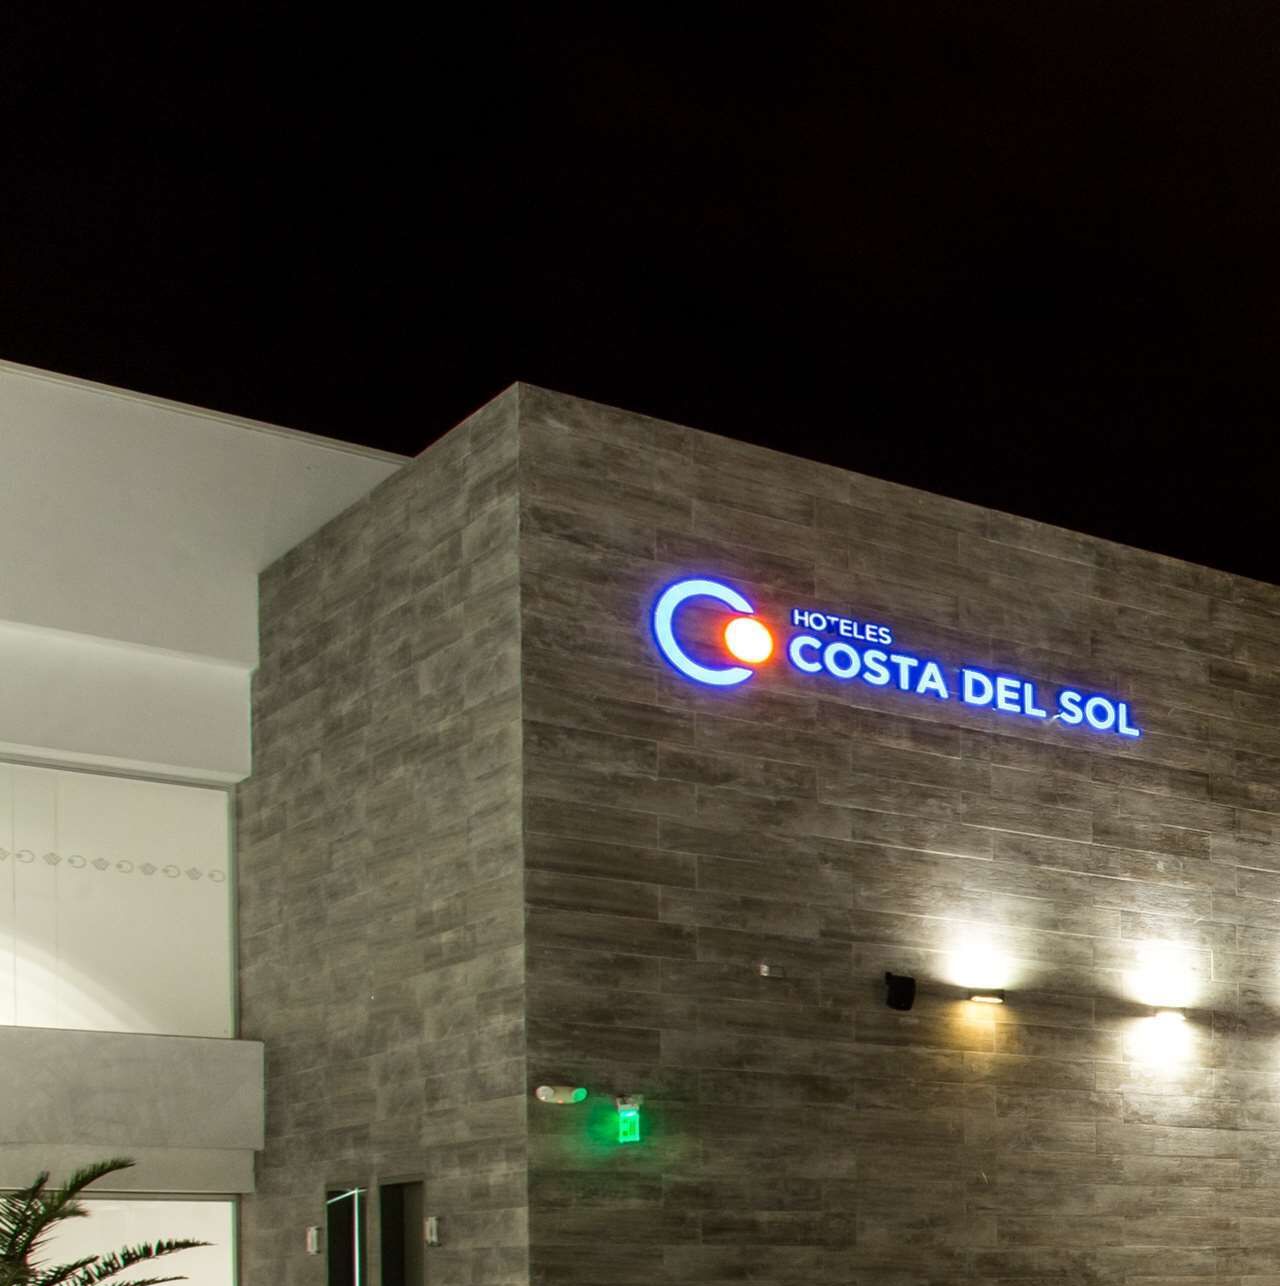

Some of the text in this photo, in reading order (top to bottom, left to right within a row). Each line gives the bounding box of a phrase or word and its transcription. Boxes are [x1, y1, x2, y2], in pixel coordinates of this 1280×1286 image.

[793, 609, 893, 645] HOTELES
[788, 635, 1141, 738] COSTA DEL SOL
